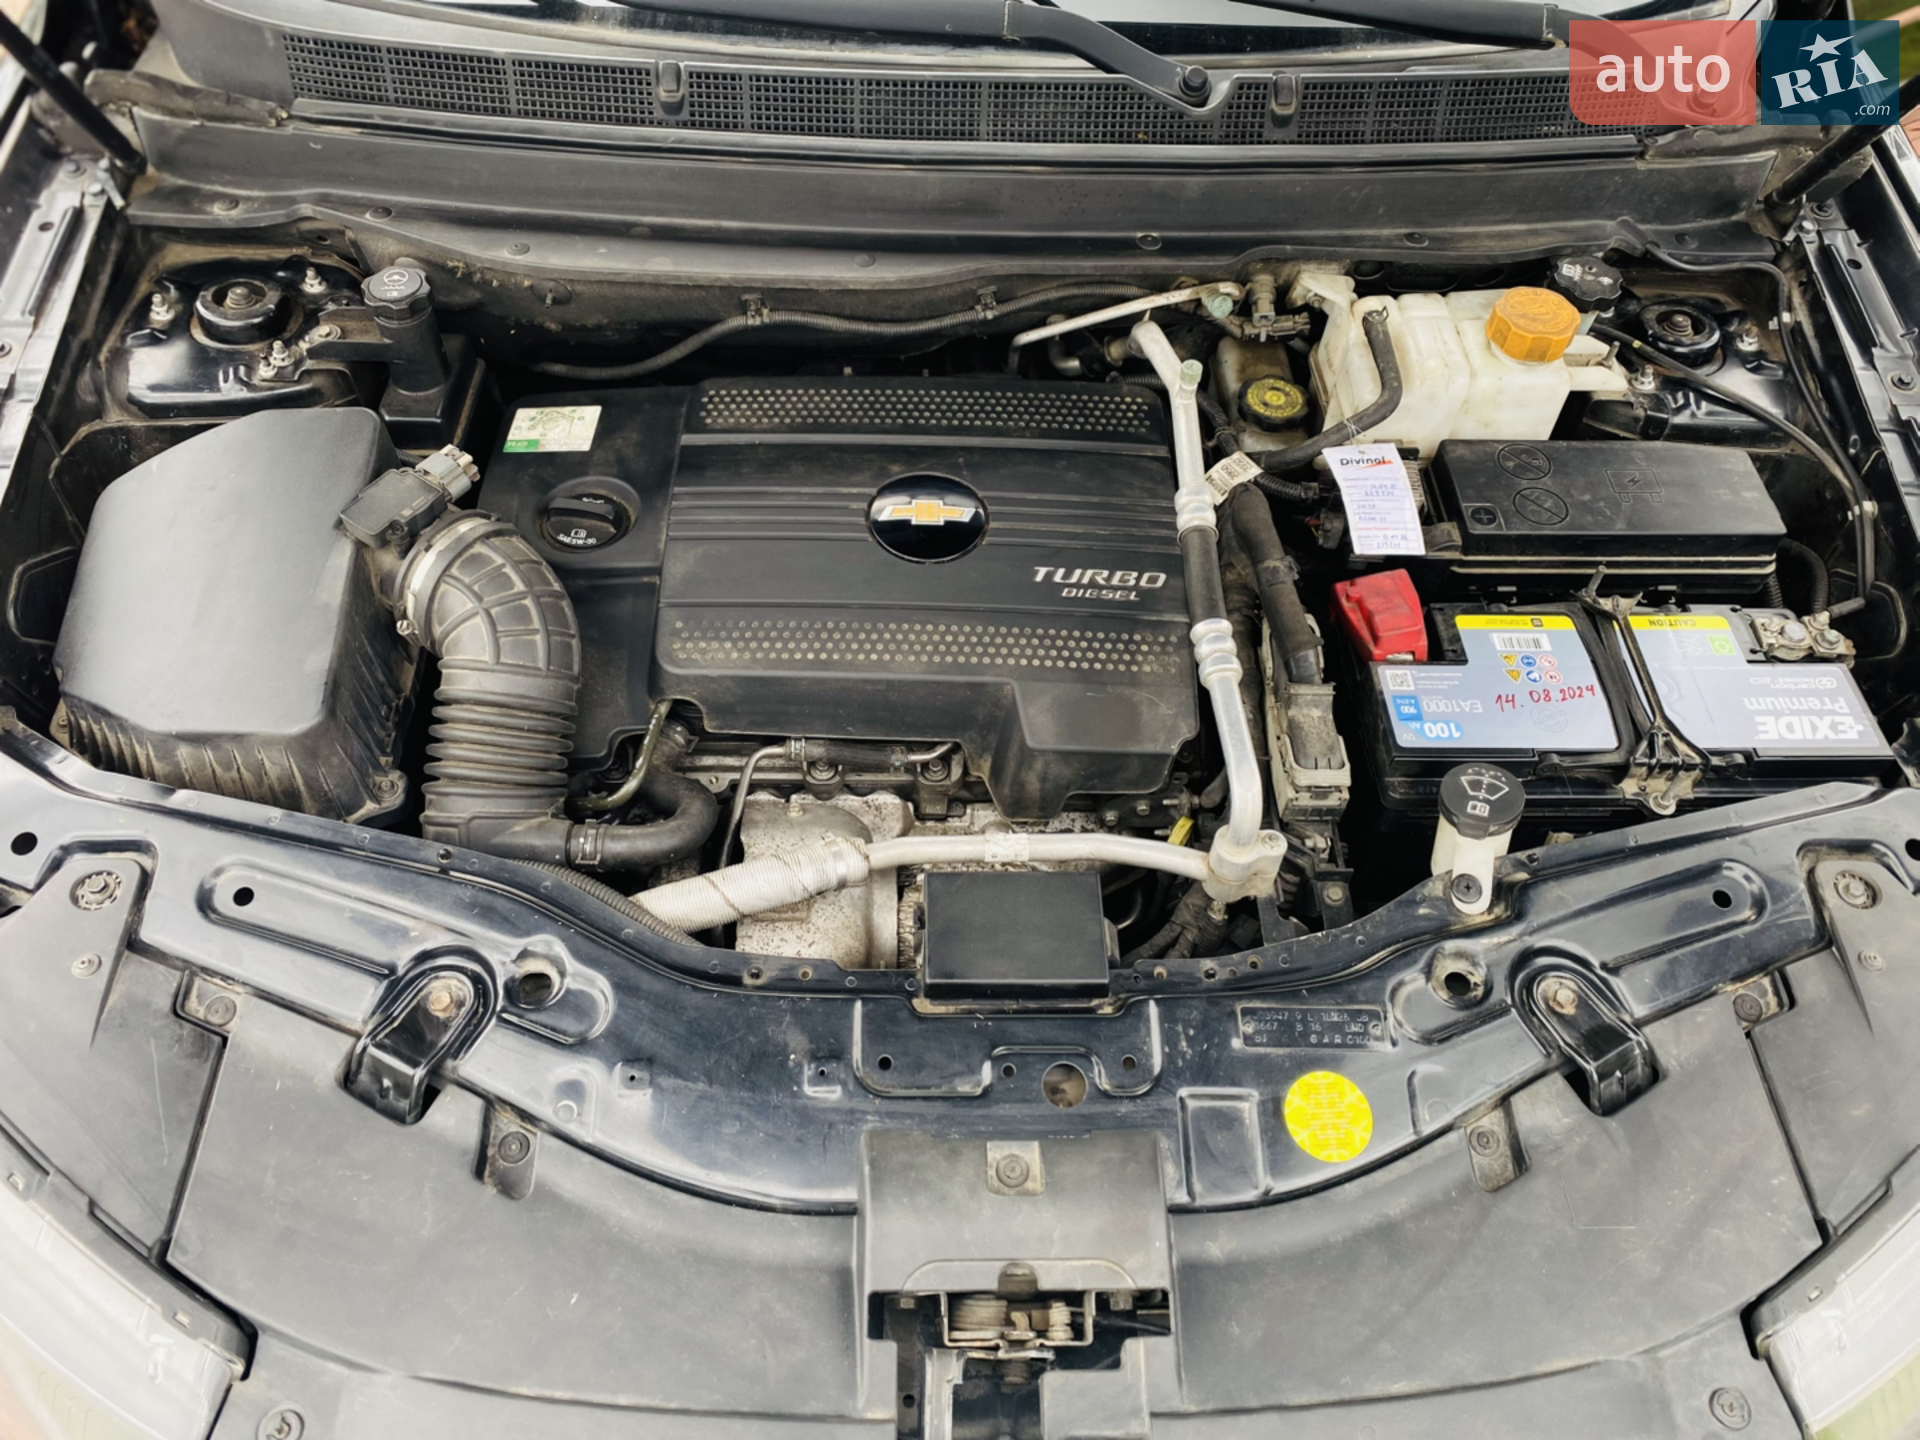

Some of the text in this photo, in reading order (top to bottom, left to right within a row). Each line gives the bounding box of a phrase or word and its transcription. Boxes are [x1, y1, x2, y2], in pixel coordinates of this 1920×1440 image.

[1340, 456, 1385, 466] Divinol
[1033, 566, 1167, 588] TURBO
[1061, 587, 1140, 601] DIESEL
[1648, 618, 1696, 627] CAUTION
[1782, 676, 1815, 684] boost
[1399, 705, 1417, 714] 900
[1423, 699, 1483, 713] EA1000
[1743, 696, 1850, 714] Premium
[1409, 721, 1461, 739] 100 Ah
[1754, 715, 1863, 740] EXIDE
[1402, 732, 1416, 741] 12V
